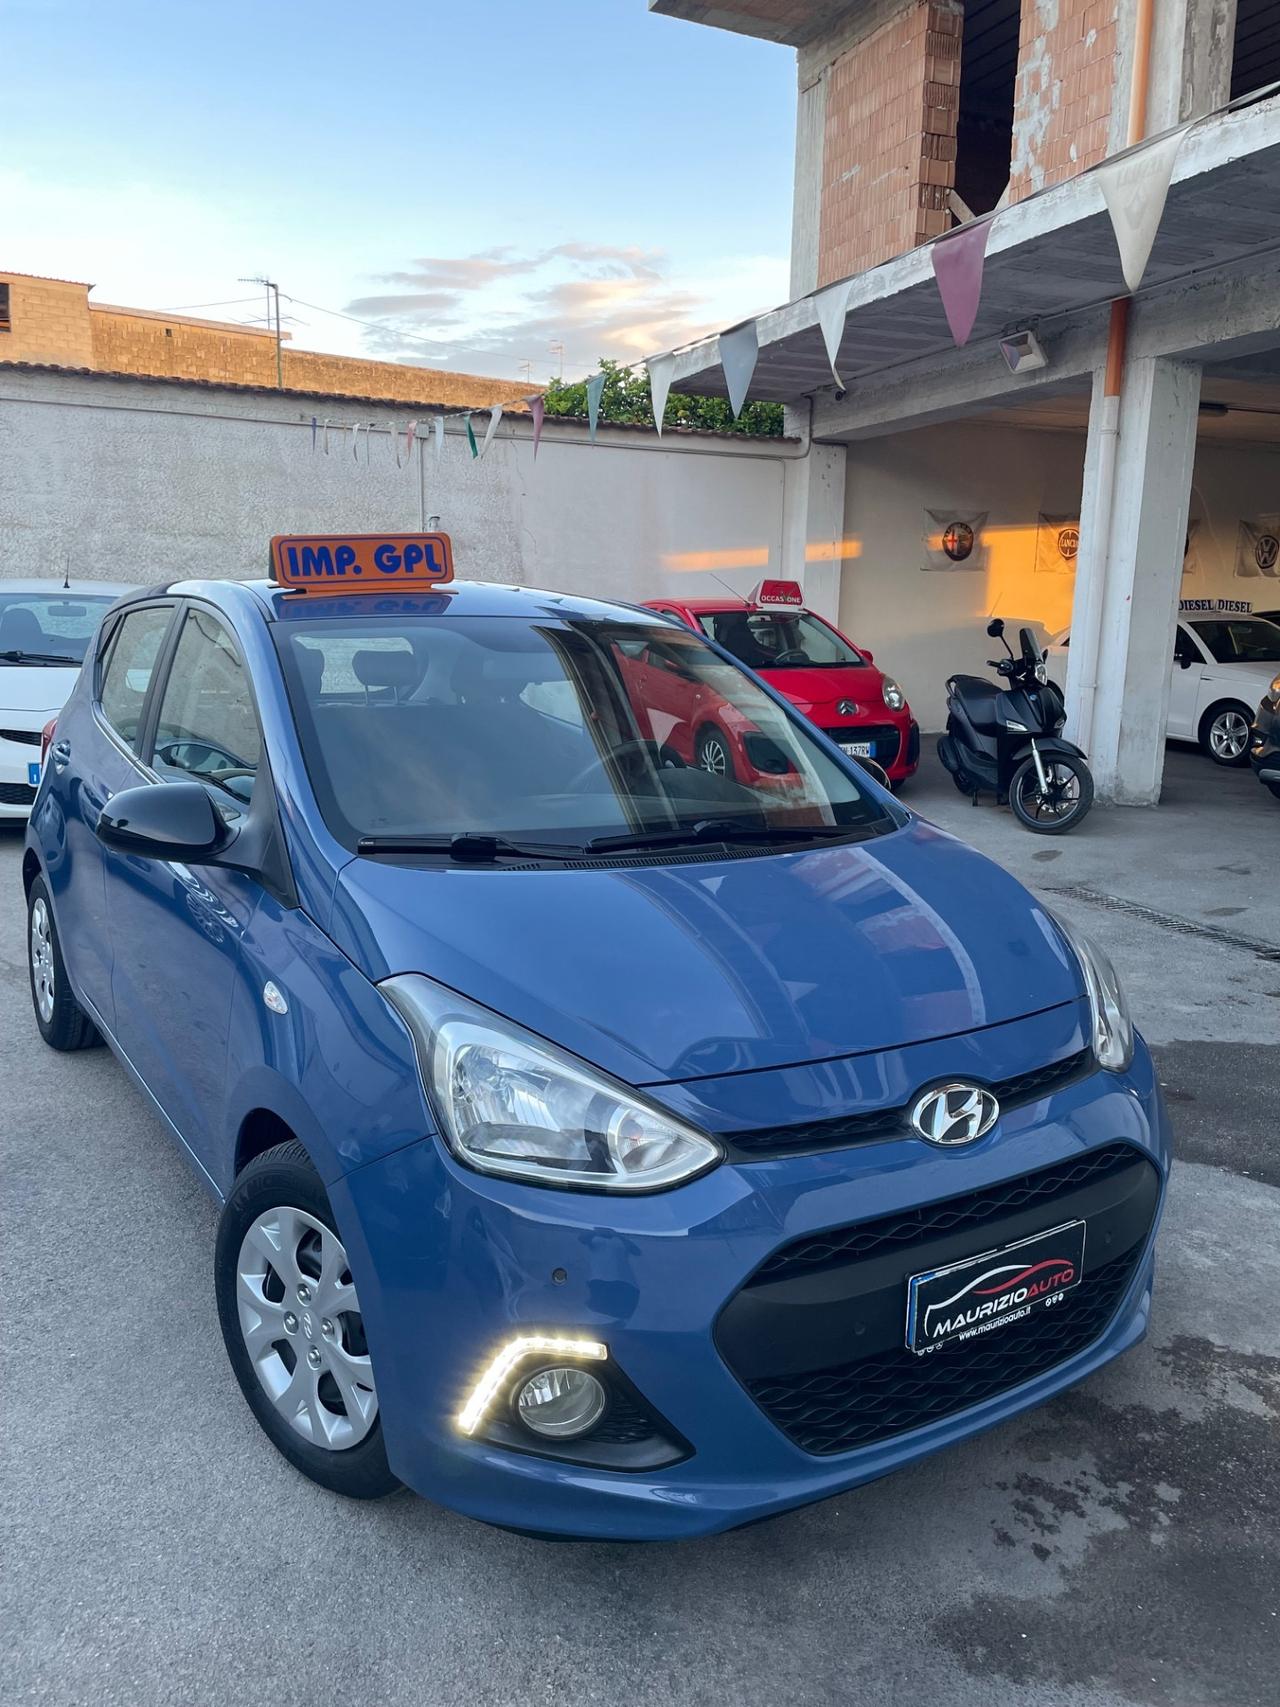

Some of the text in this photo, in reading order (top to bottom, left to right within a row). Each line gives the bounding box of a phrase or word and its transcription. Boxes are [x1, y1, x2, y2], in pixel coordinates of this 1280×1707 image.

[287, 544, 442, 577] IMP. GPL
[1179, 599, 1252, 613] DIESEL DIESEL
